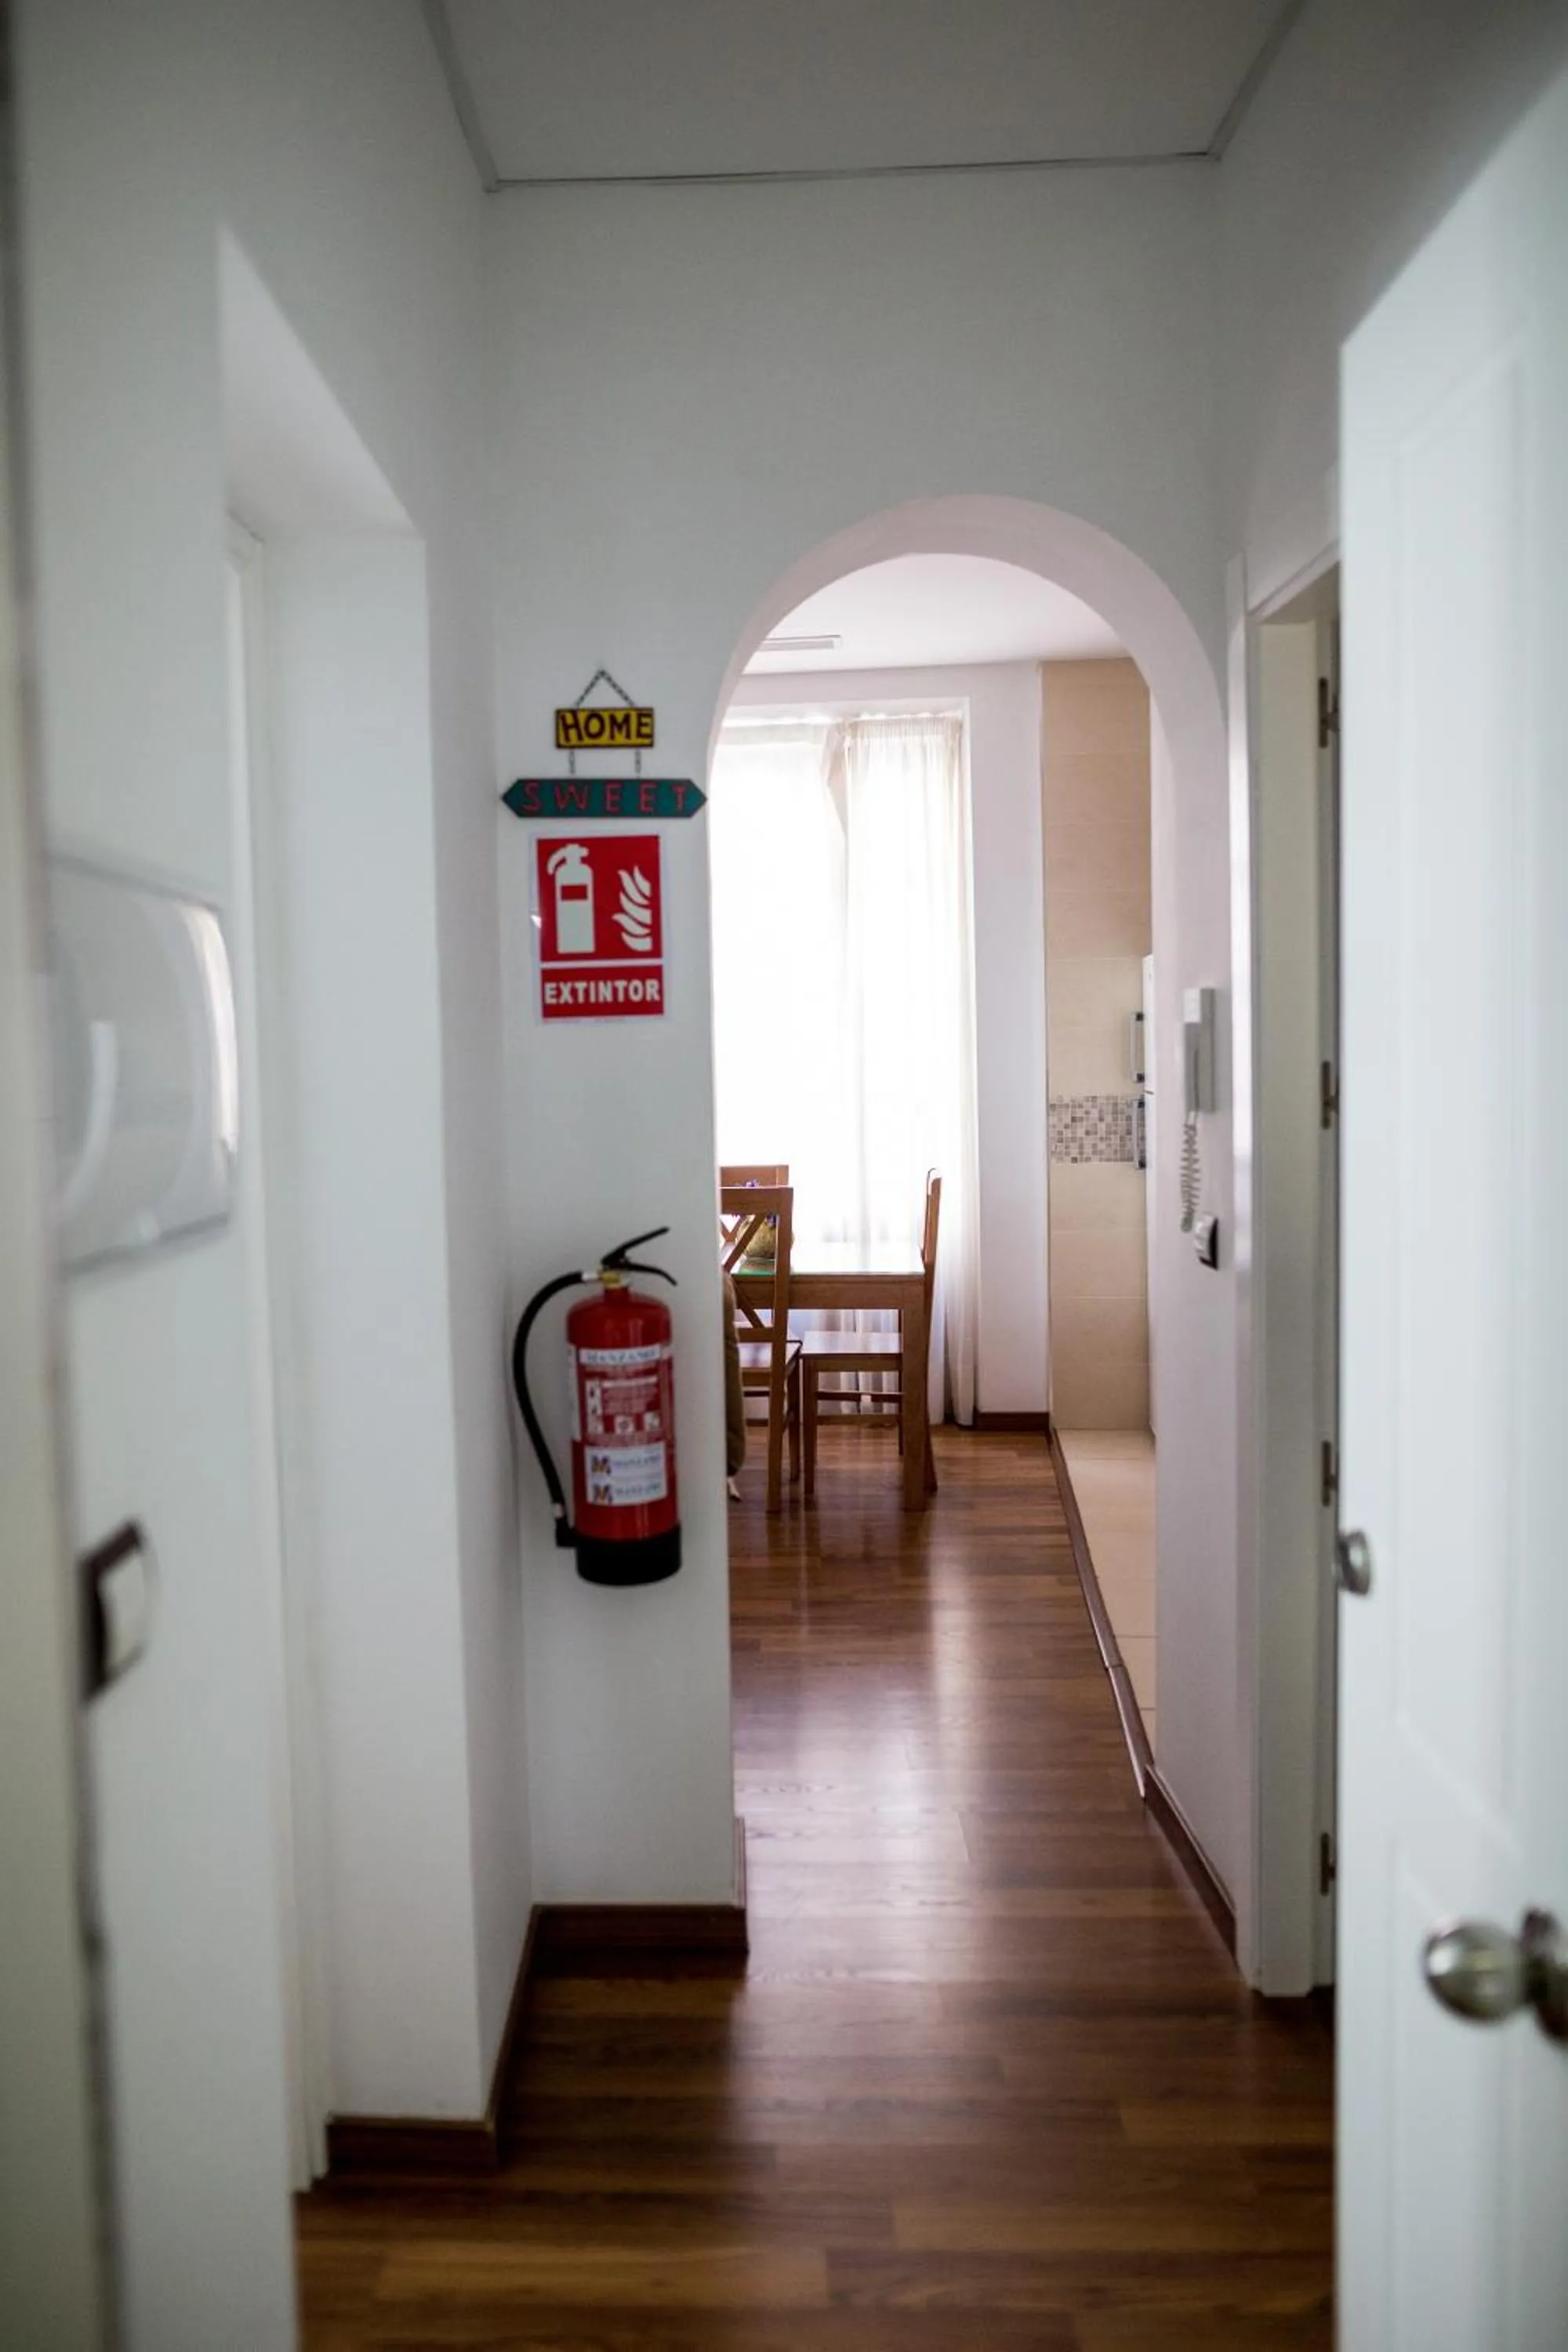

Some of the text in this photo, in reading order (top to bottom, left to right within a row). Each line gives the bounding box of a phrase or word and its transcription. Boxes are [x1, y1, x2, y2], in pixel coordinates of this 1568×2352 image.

[560, 710, 653, 743] HOME
[522, 781, 688, 813] SWEET
[543, 978, 661, 1005] EXTINTOR
